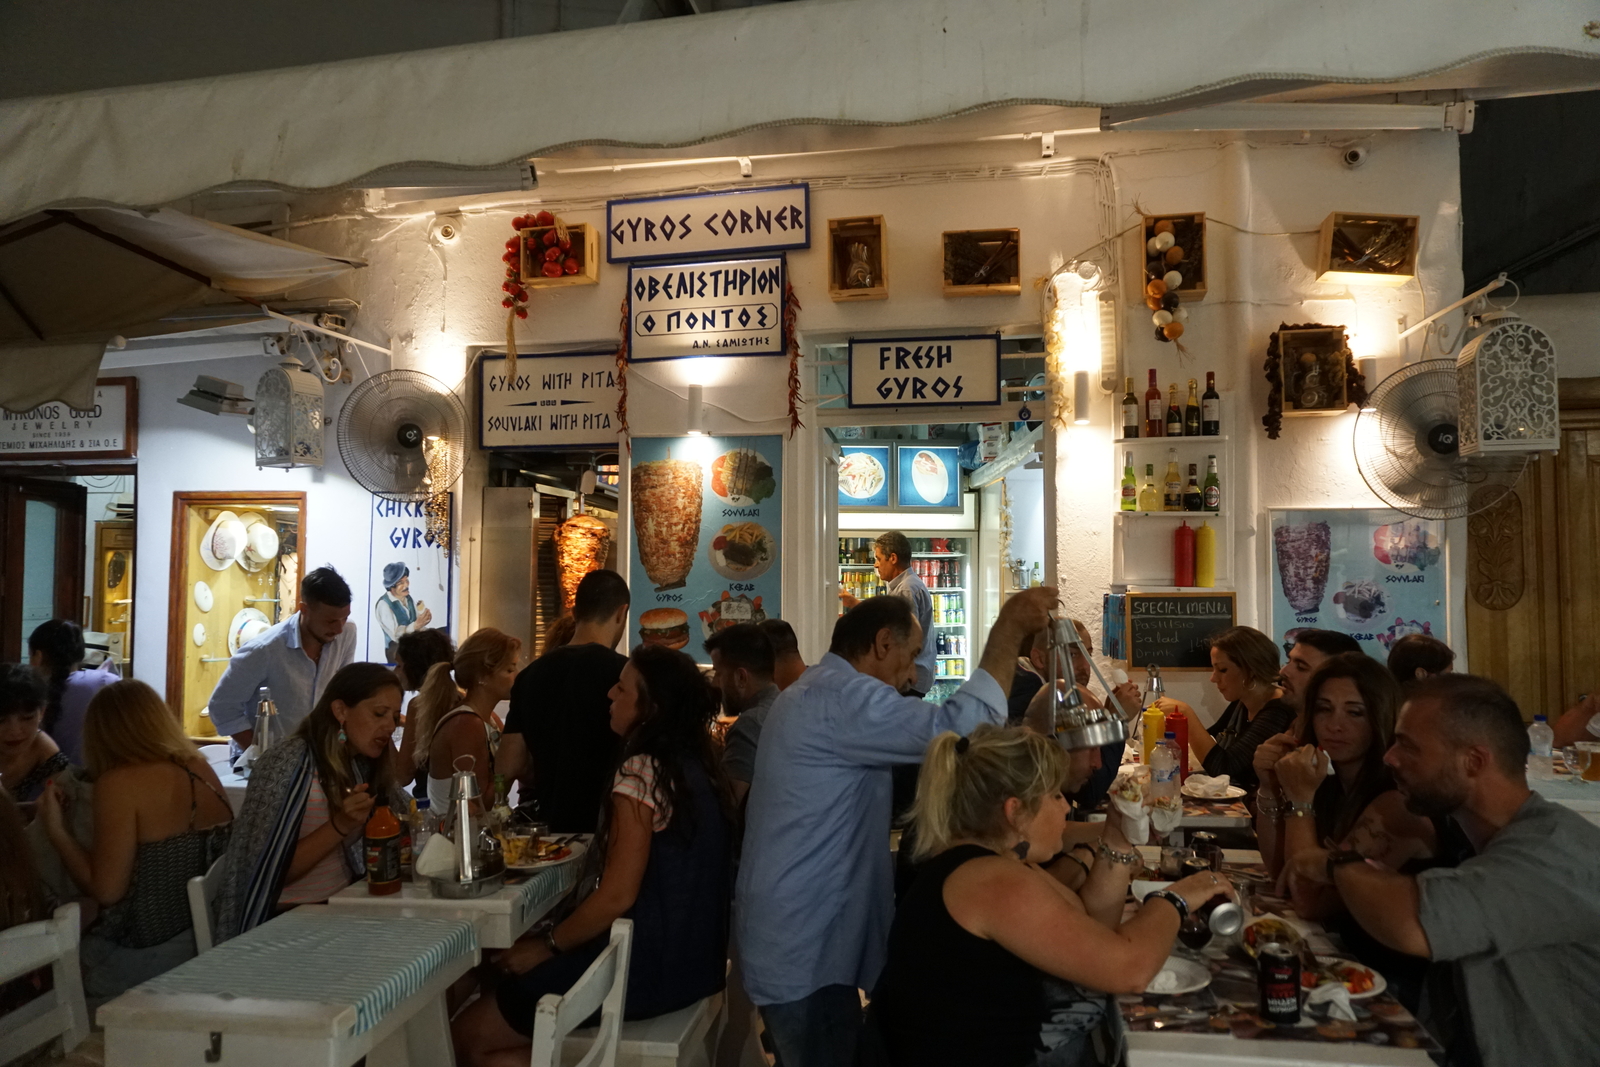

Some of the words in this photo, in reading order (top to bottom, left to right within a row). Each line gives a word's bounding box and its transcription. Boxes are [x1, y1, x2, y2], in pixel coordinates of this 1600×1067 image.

[611, 214, 692, 245] GYROS
[704, 205, 804, 236] CORNER
[634, 266, 780, 302] ΟΒΕΛΙΣΤΗΡΙΟΝ
[667, 306, 768, 332] ΠΟΝΤΟΣ
[880, 345, 952, 370] FRESH
[489, 375, 531, 391] GYROS
[542, 372, 572, 390] WITH
[582, 371, 615, 388] PITA
[876, 376, 963, 400] GYROS
[488, 415, 541, 432] SOUVLAKI
[550, 414, 577, 430] WITH
[583, 413, 611, 430] PITA
[729, 583, 755, 591] KEBAB
[655, 594, 683, 602] GYROS
[1133, 601, 1183, 614] SPECIAL
[1135, 631, 1179, 643] Salad
[1136, 648, 1175, 658] Drink
